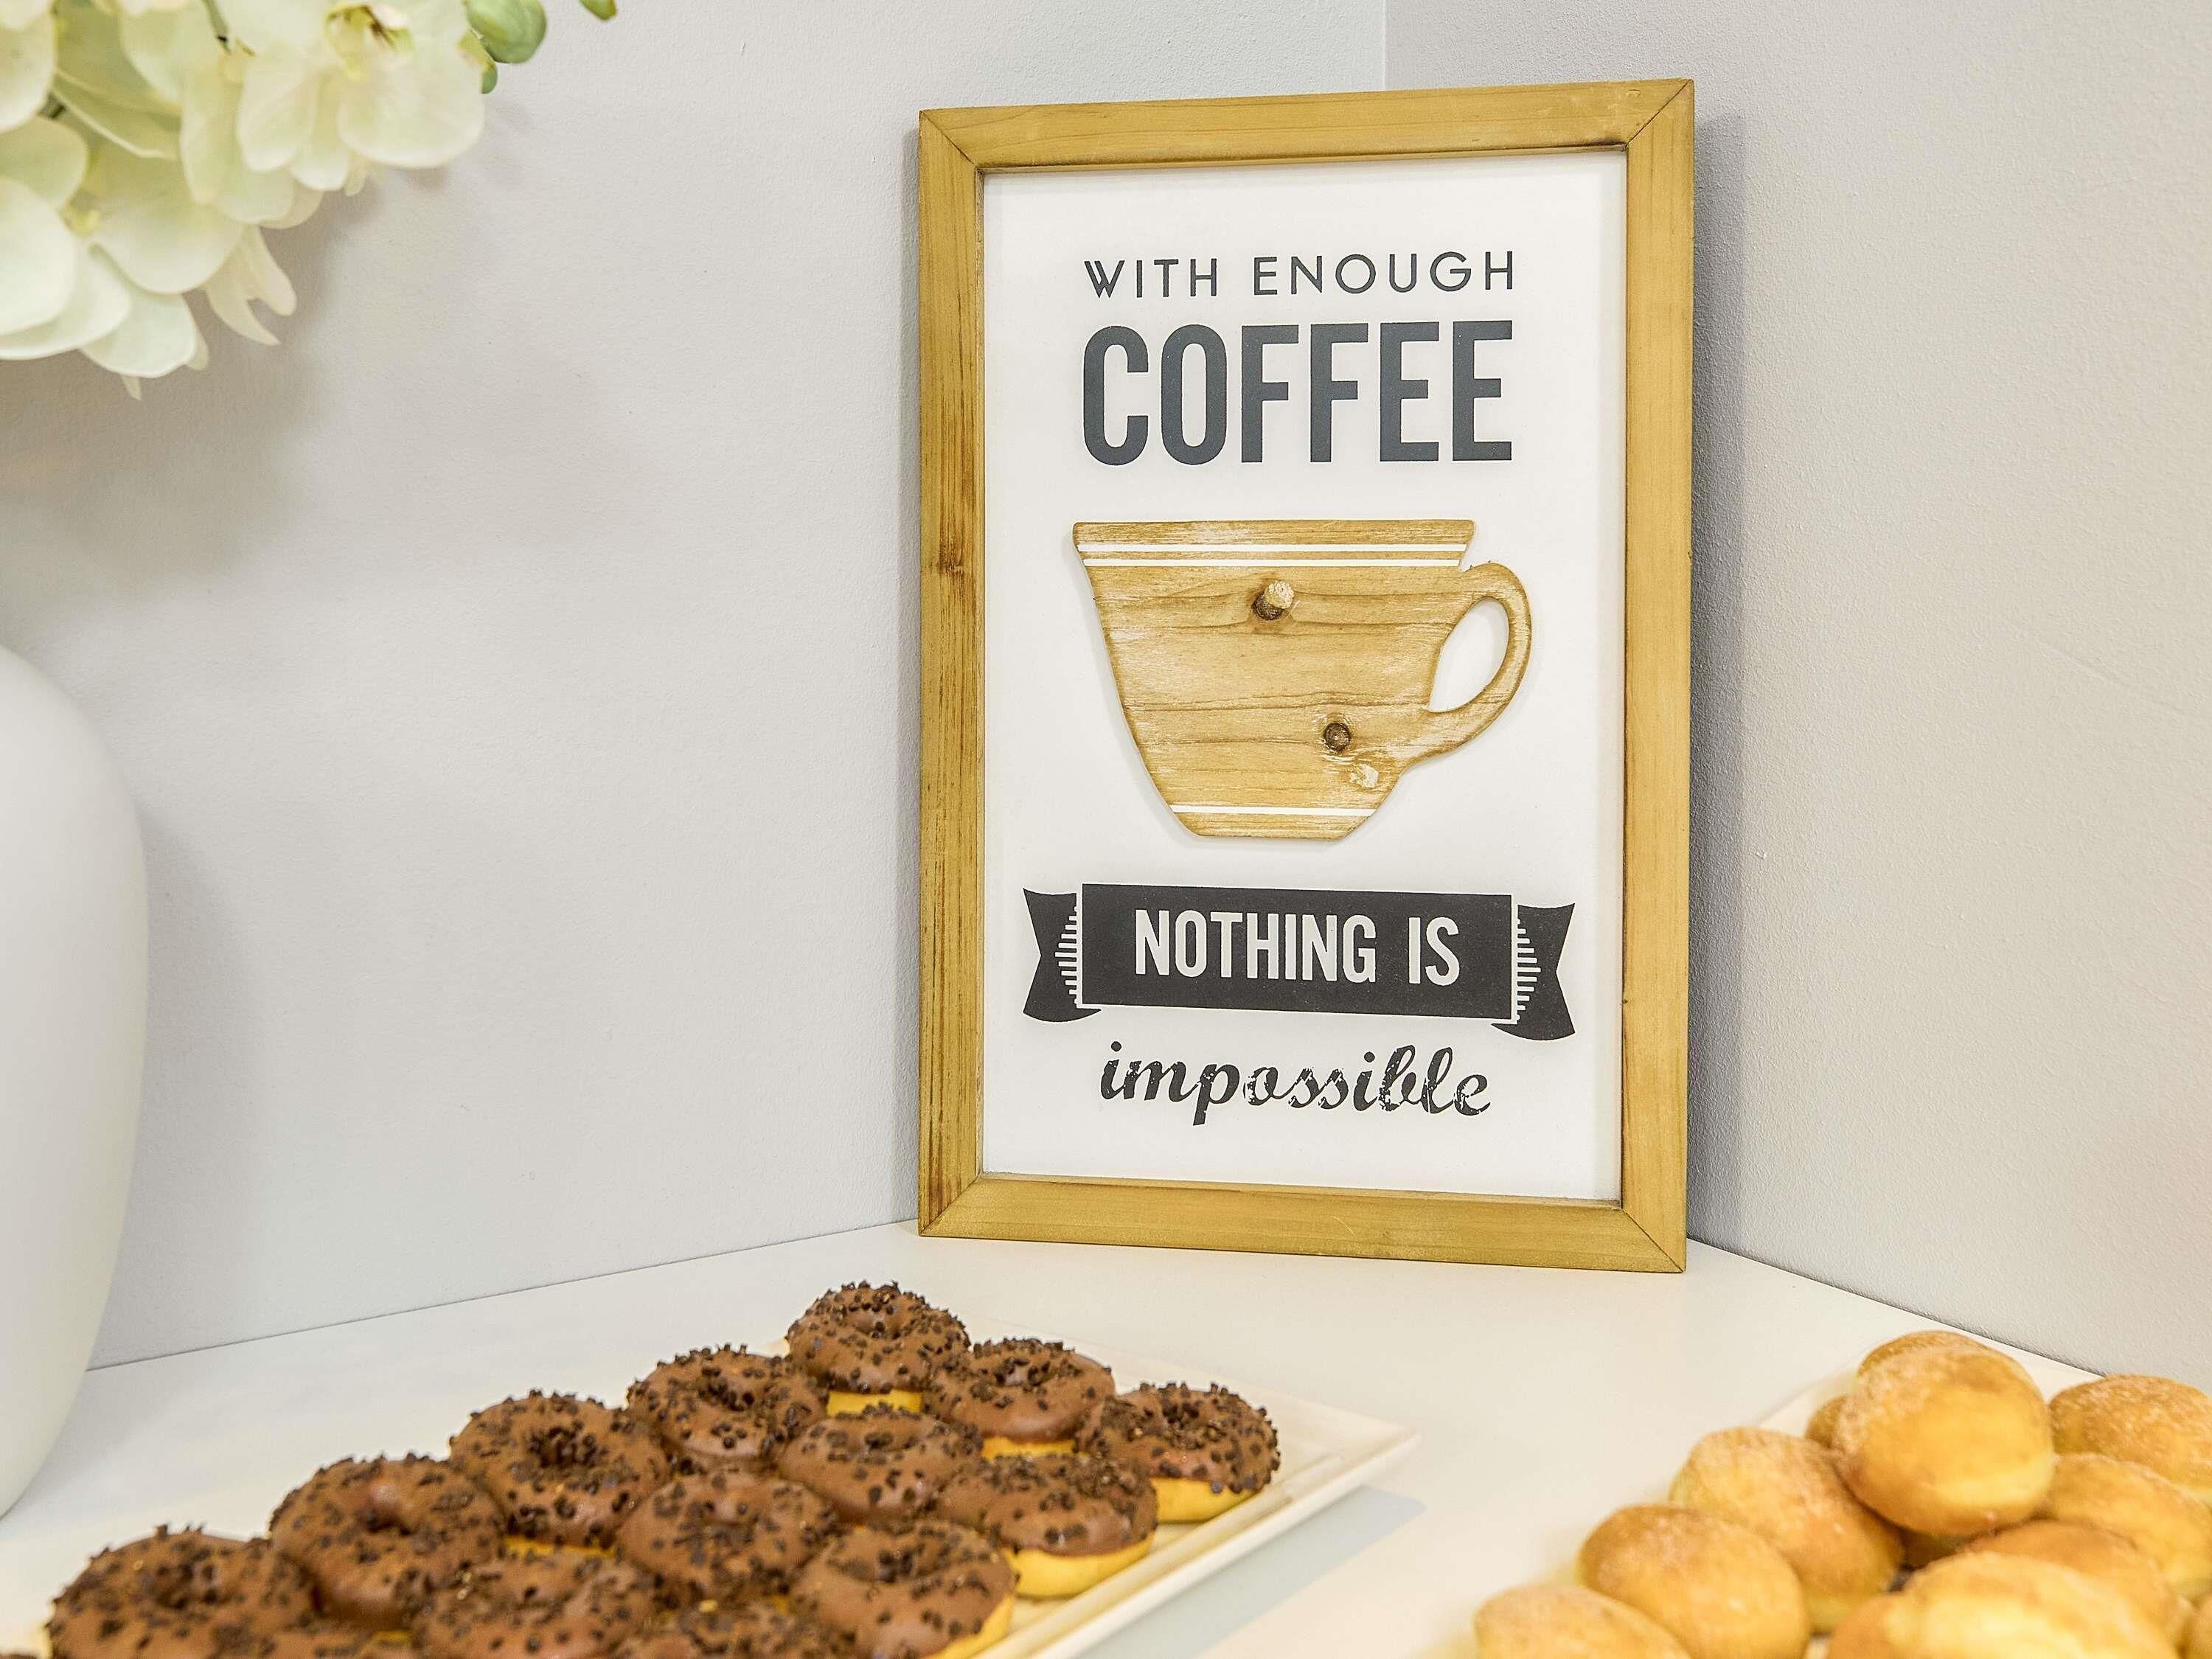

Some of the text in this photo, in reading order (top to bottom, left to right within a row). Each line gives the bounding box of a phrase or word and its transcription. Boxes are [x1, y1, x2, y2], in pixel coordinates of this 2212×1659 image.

[1084, 251, 1513, 298] WITH ENOUGH
[1082, 319, 1513, 466] COFFEE
[1135, 909, 1460, 987] NOTHING IS
[1100, 1040, 1491, 1127] impossible
